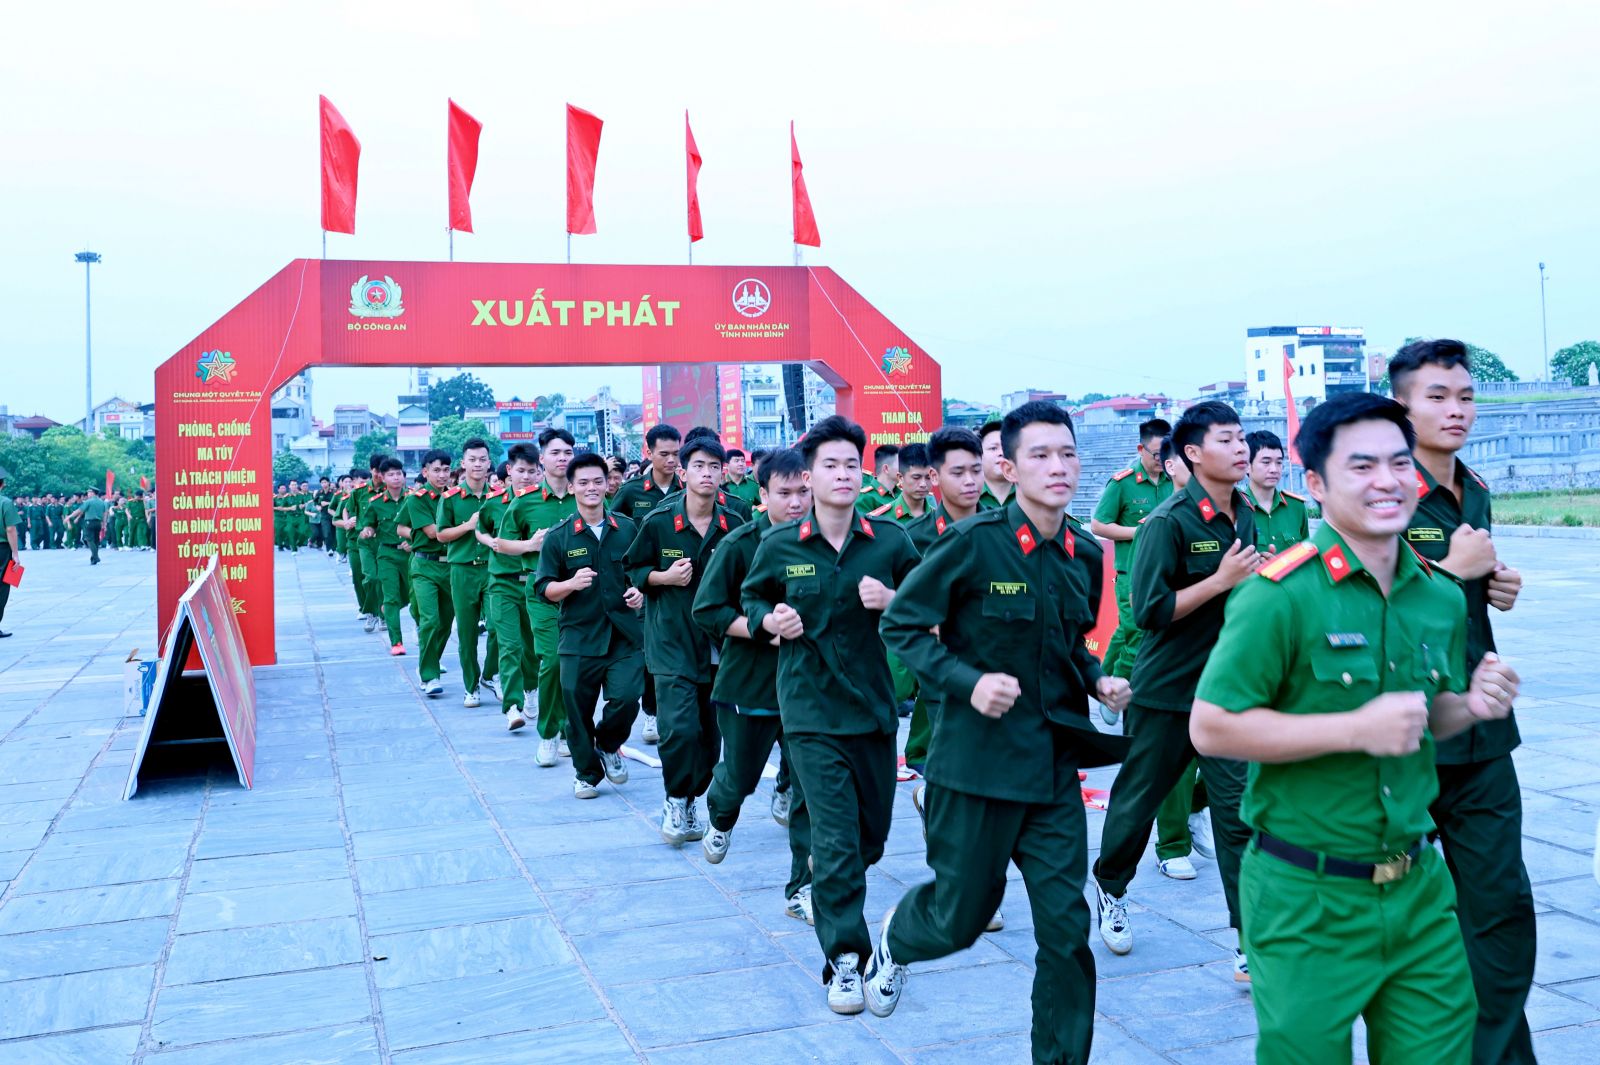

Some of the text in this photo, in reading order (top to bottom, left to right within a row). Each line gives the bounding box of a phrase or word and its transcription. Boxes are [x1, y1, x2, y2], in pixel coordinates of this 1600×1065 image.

[471, 288, 680, 326] XUẤT PHÁT
[347, 322, 407, 332] BỘ CÔNG AN
[714, 322, 727, 330] ỦY
[746, 322, 771, 330] NHÂN
[771, 322, 790, 330] DÂN
[764, 330, 784, 338] BÌNH
[201, 391, 218, 399] MỘT
[219, 390, 245, 398] QUYẾT
[881, 411, 922, 424] THAM GIA
[178, 418, 252, 438] PHÒNG, CHỐNG
[870, 430, 903, 446] PHÒNG,
[197, 444, 233, 461] MA TÚY
[175, 467, 256, 486] LÀ TRÁCH NHIỆM
[172, 490, 259, 510] CỦA MỖI CÁ NHÂN
[171, 516, 262, 534] GIA ĐÌNH, CƠ QUAN
[177, 537, 256, 558] TỔ CHỨC VÀ CỦA
[230, 563, 248, 583] HỘI
